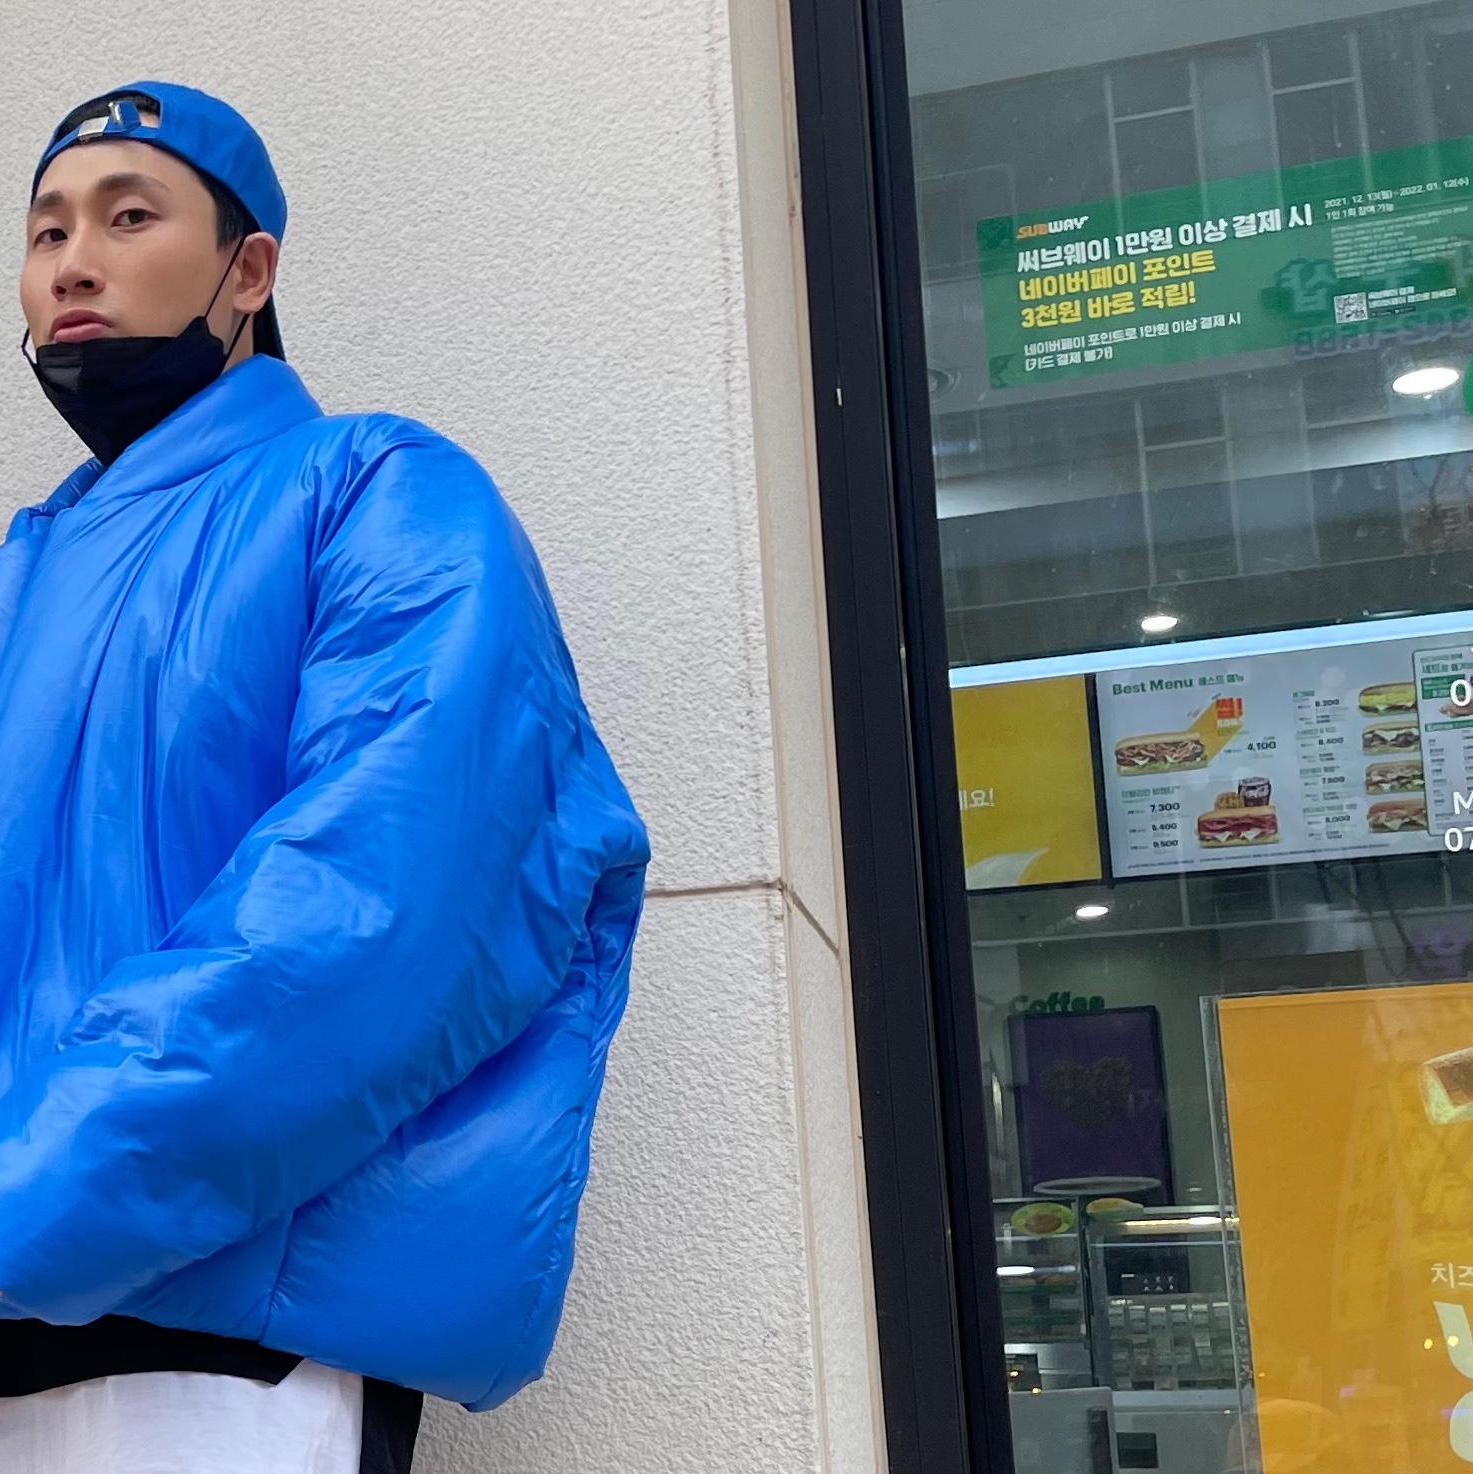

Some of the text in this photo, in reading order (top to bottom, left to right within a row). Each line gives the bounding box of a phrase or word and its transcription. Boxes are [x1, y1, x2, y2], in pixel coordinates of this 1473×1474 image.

[1016, 216, 1089, 239] SUBWAY
[1017, 203, 1313, 272] 써브웨이 1만원 이상 결제 시
[1019, 250, 1216, 301] 네이버페이 포인트
[1021, 280, 1197, 329] 3천원 바로 적립!
[1024, 311, 1242, 356] 네이버페이 포인트로 1만원 이상 결제 시
[1056, 349, 1082, 366] 결제
[1112, 681, 1147, 696] Best
[1150, 676, 1194, 692] Menu
